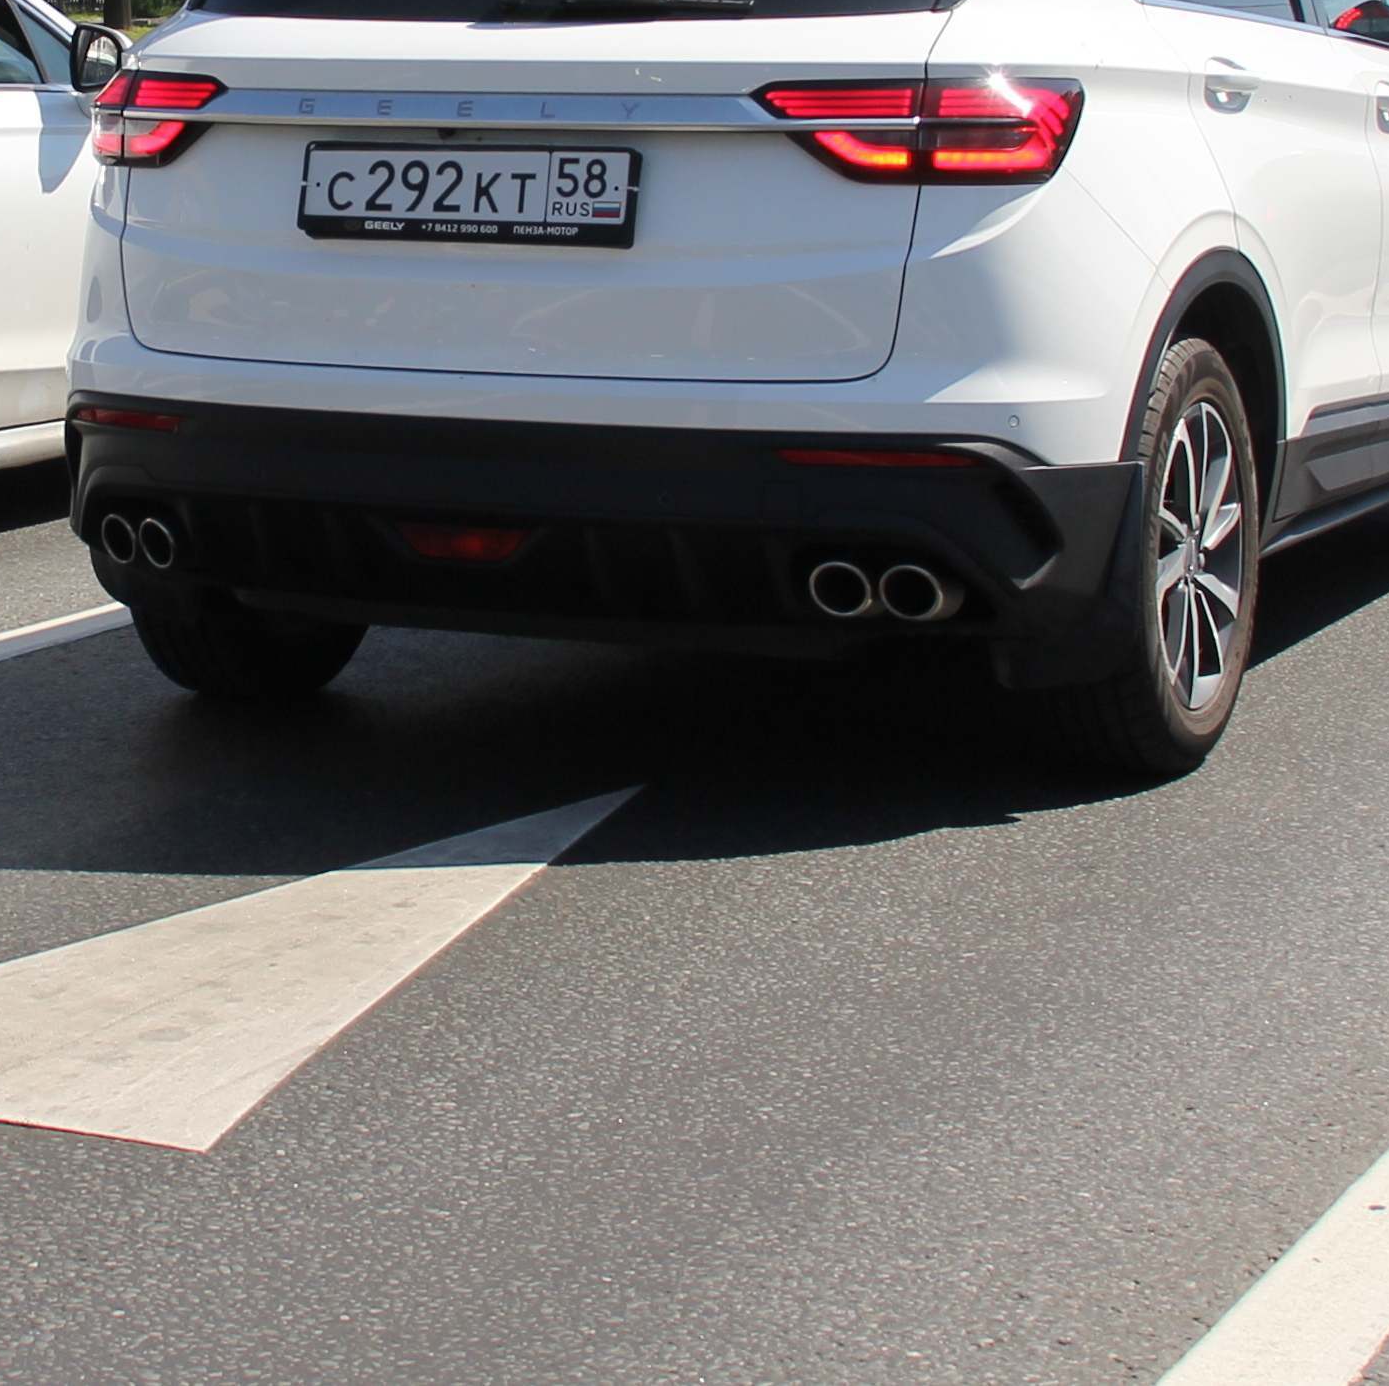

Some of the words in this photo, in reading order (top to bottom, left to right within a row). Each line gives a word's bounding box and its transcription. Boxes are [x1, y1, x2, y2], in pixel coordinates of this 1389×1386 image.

[298, 98, 642, 119] GEELY
[327, 160, 537, 214] С292КТ
[555, 157, 608, 199] 58
[551, 201, 591, 217] RUS
[364, 219, 406, 231] GEELY
[434, 223, 459, 234] 8412
[460, 224, 479, 234] 990
[512, 225, 580, 237] ПЕНЗА-МОТОР
